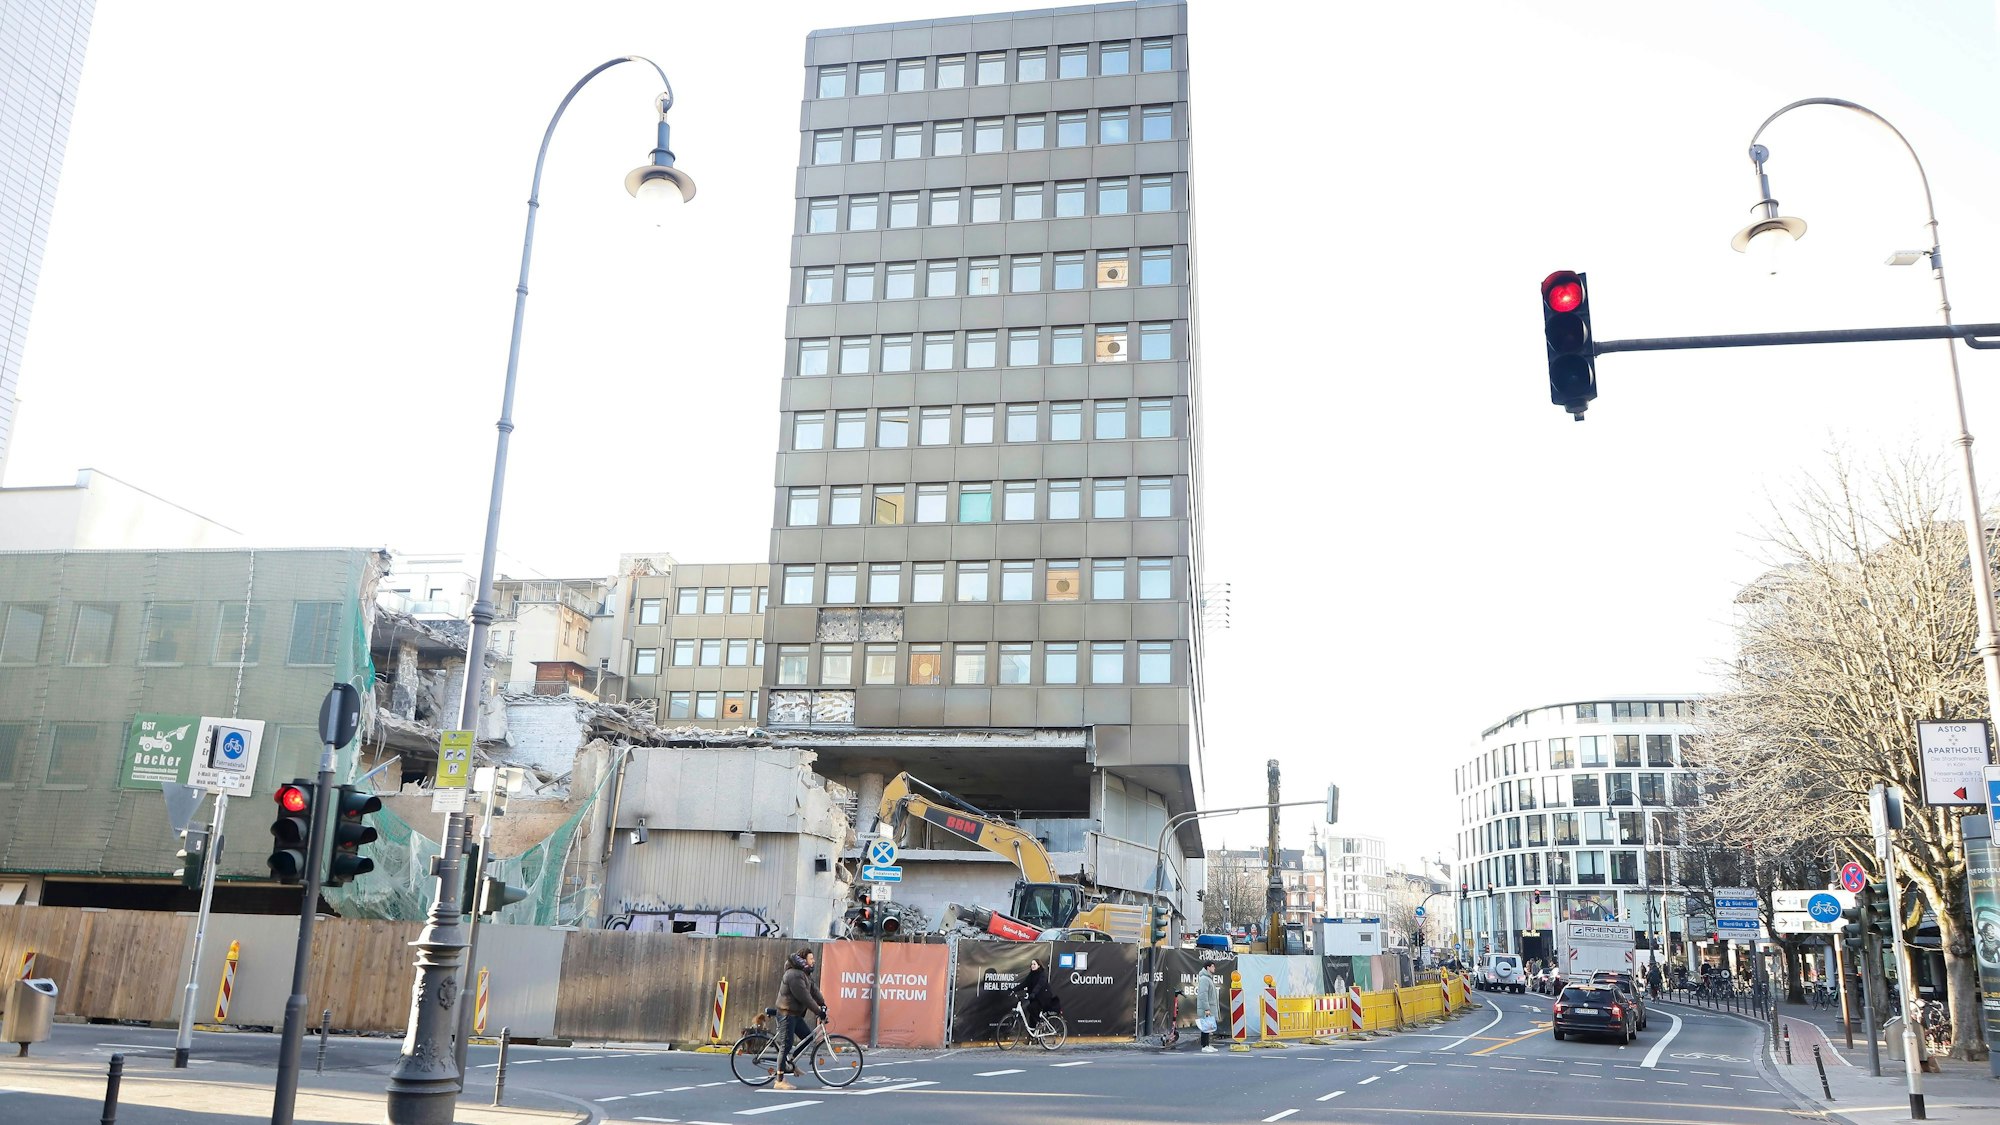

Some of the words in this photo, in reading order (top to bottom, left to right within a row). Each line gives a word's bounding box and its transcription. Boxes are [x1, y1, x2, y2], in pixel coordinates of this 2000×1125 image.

[142, 721, 156, 730] BST
[134, 752, 181, 767] Becker
[946, 816, 976, 834] BBM
[1585, 926, 1629, 934] RHENUS
[841, 971, 928, 986] INNOVATION
[1070, 971, 1113, 985] Quantum
[1180, 973, 1191, 983] IM
[1192, 974, 1224, 984] HEN
[984, 982, 999, 990] REAL
[841, 987, 857, 998] IM
[861, 988, 927, 1001] ZNTRUM
